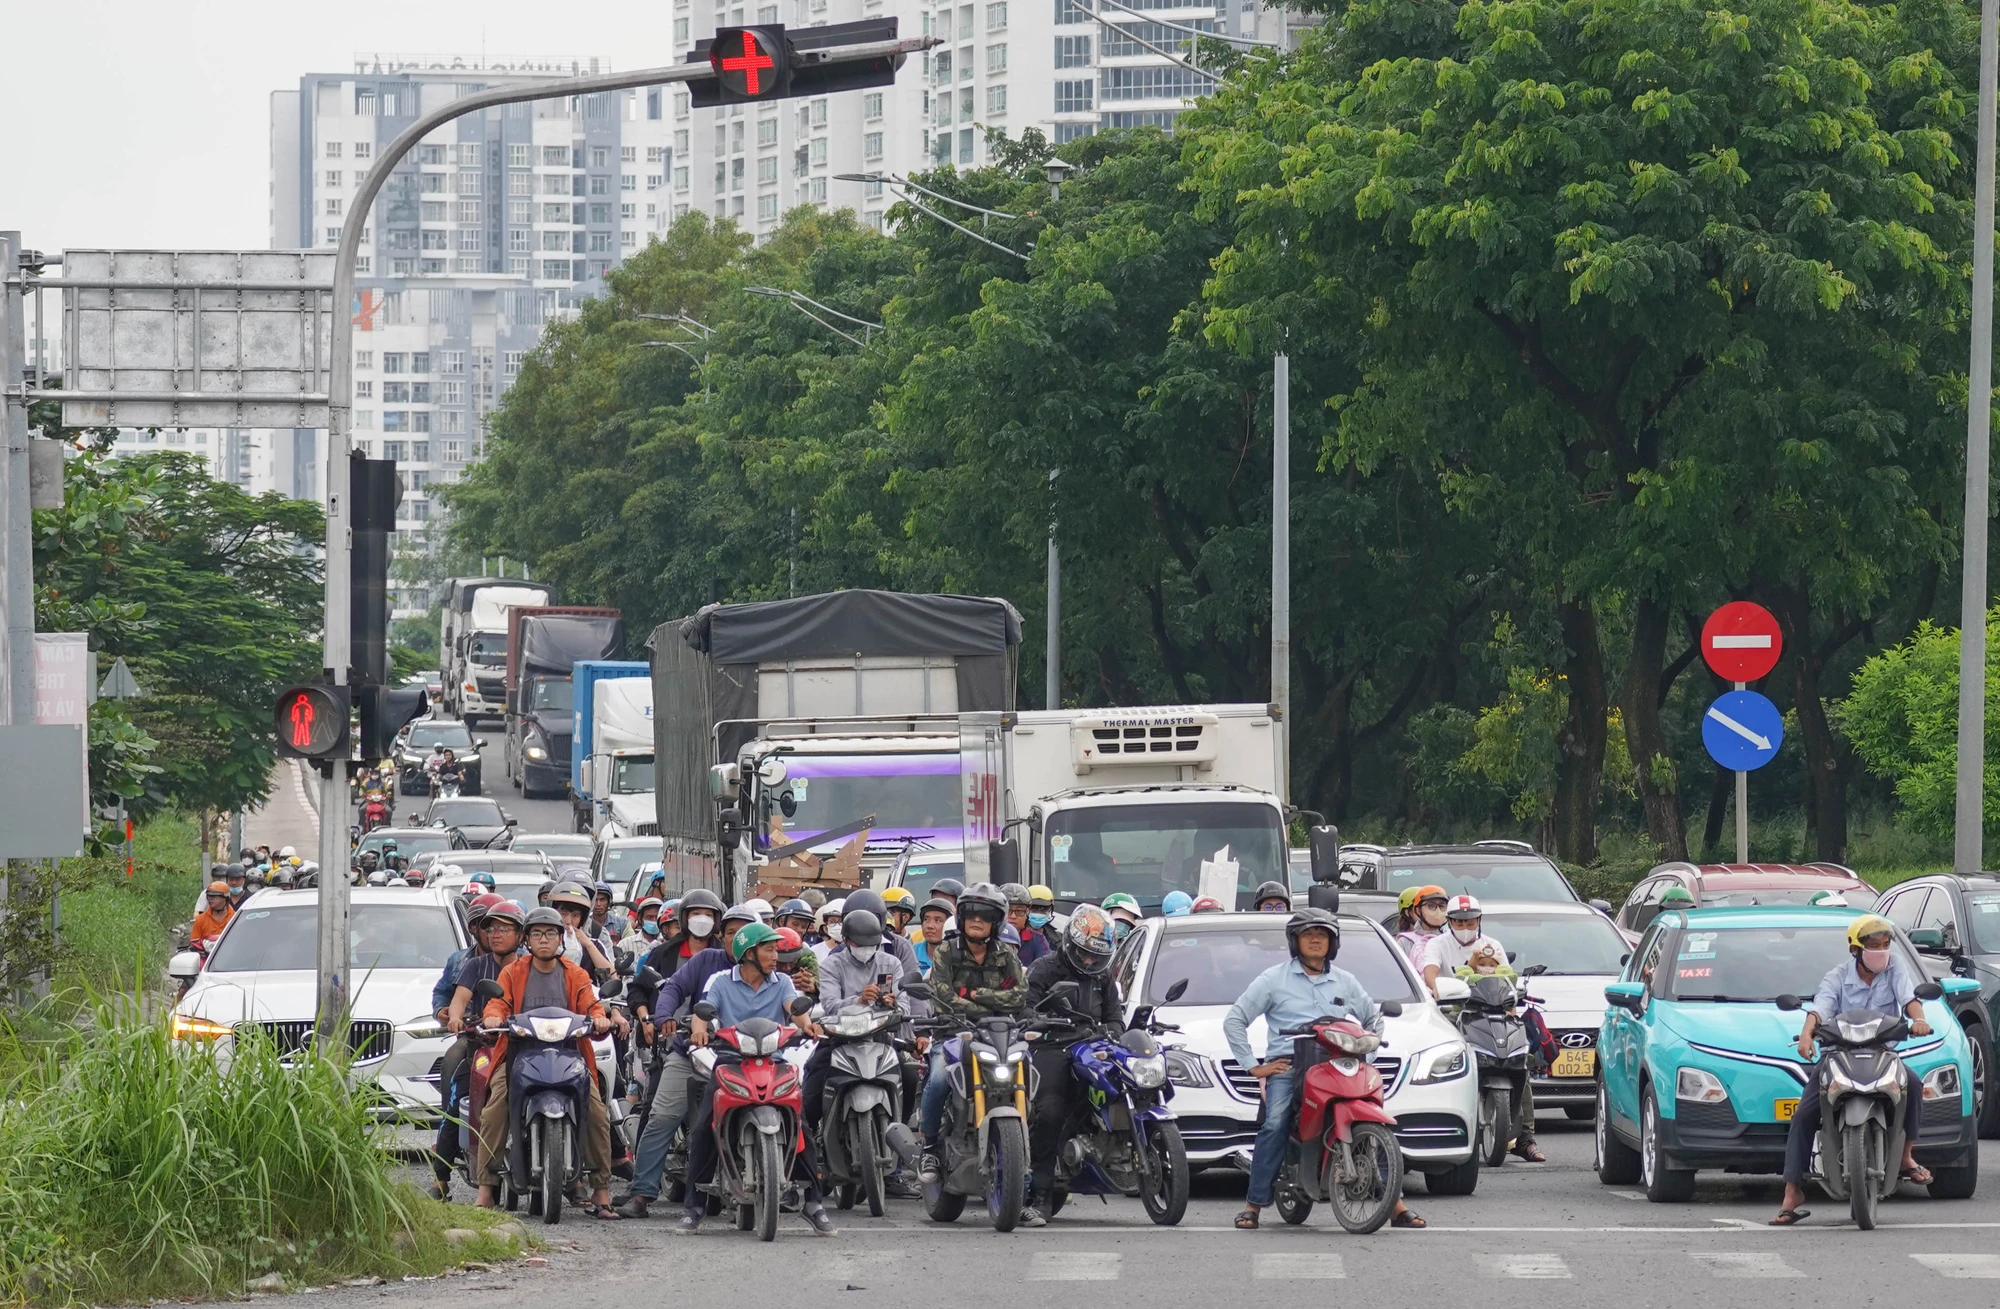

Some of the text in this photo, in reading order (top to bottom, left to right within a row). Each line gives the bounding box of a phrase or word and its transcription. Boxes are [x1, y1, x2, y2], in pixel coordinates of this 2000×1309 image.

[1154, 717, 1194, 726] MASTER
[1679, 967, 1712, 978] TAXI
[1566, 1051, 1589, 1062] 64E
[1558, 1063, 1594, 1075] 002.3
